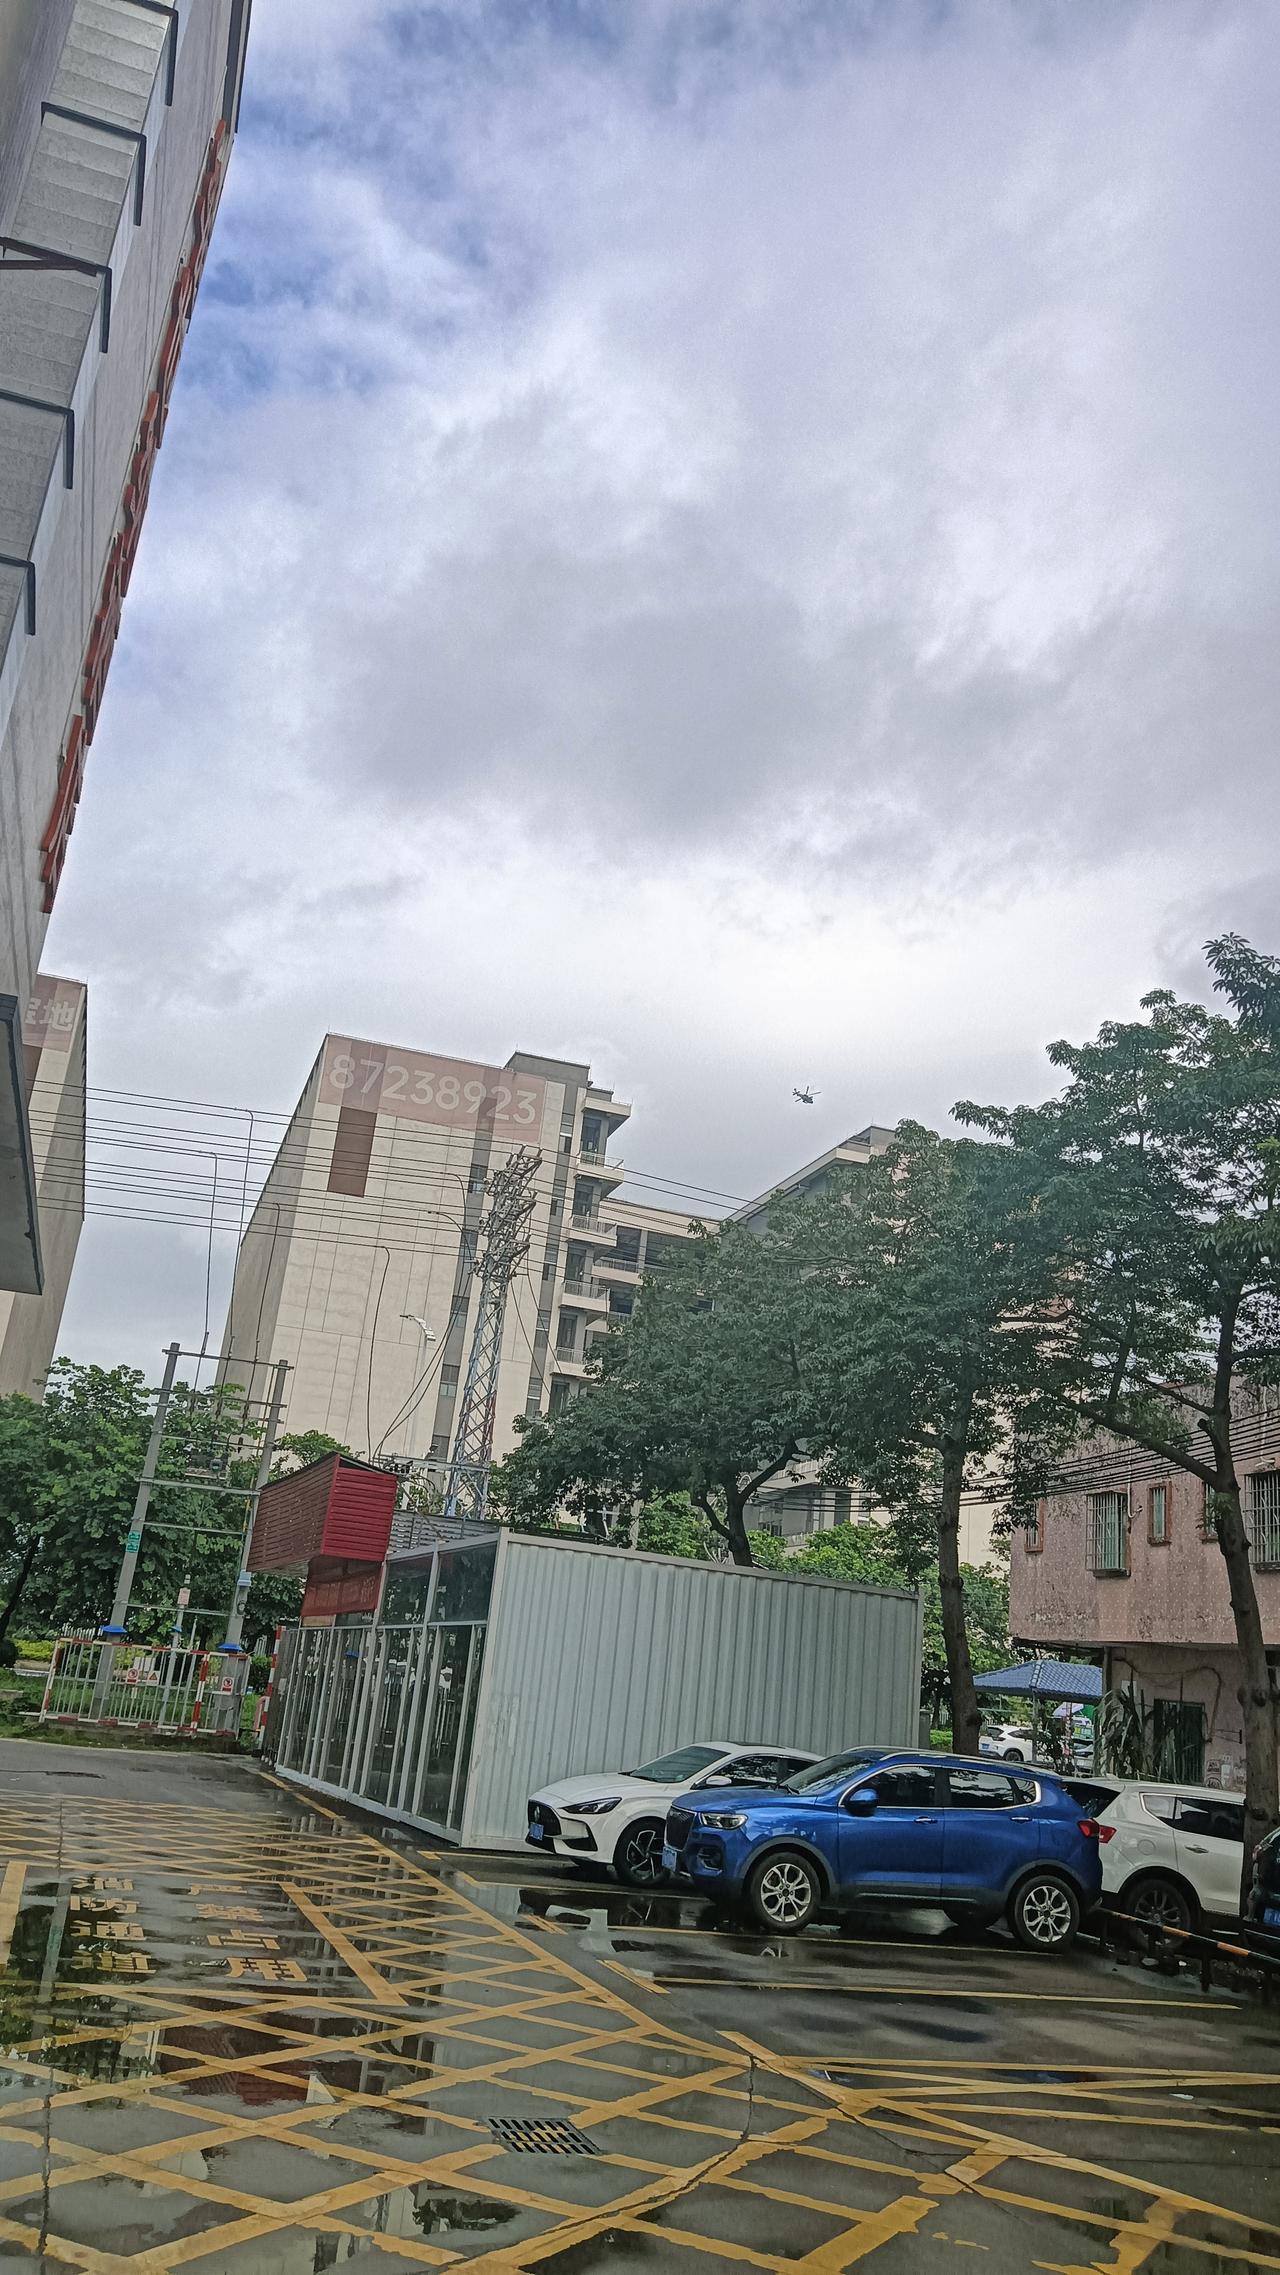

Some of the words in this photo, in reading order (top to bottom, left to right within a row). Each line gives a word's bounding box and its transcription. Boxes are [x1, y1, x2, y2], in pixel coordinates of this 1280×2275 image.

[328, 1053, 538, 1125] 87238923
[70, 1876, 157, 1974] 消防通道
[187, 1882, 308, 1982] 严禁占用
